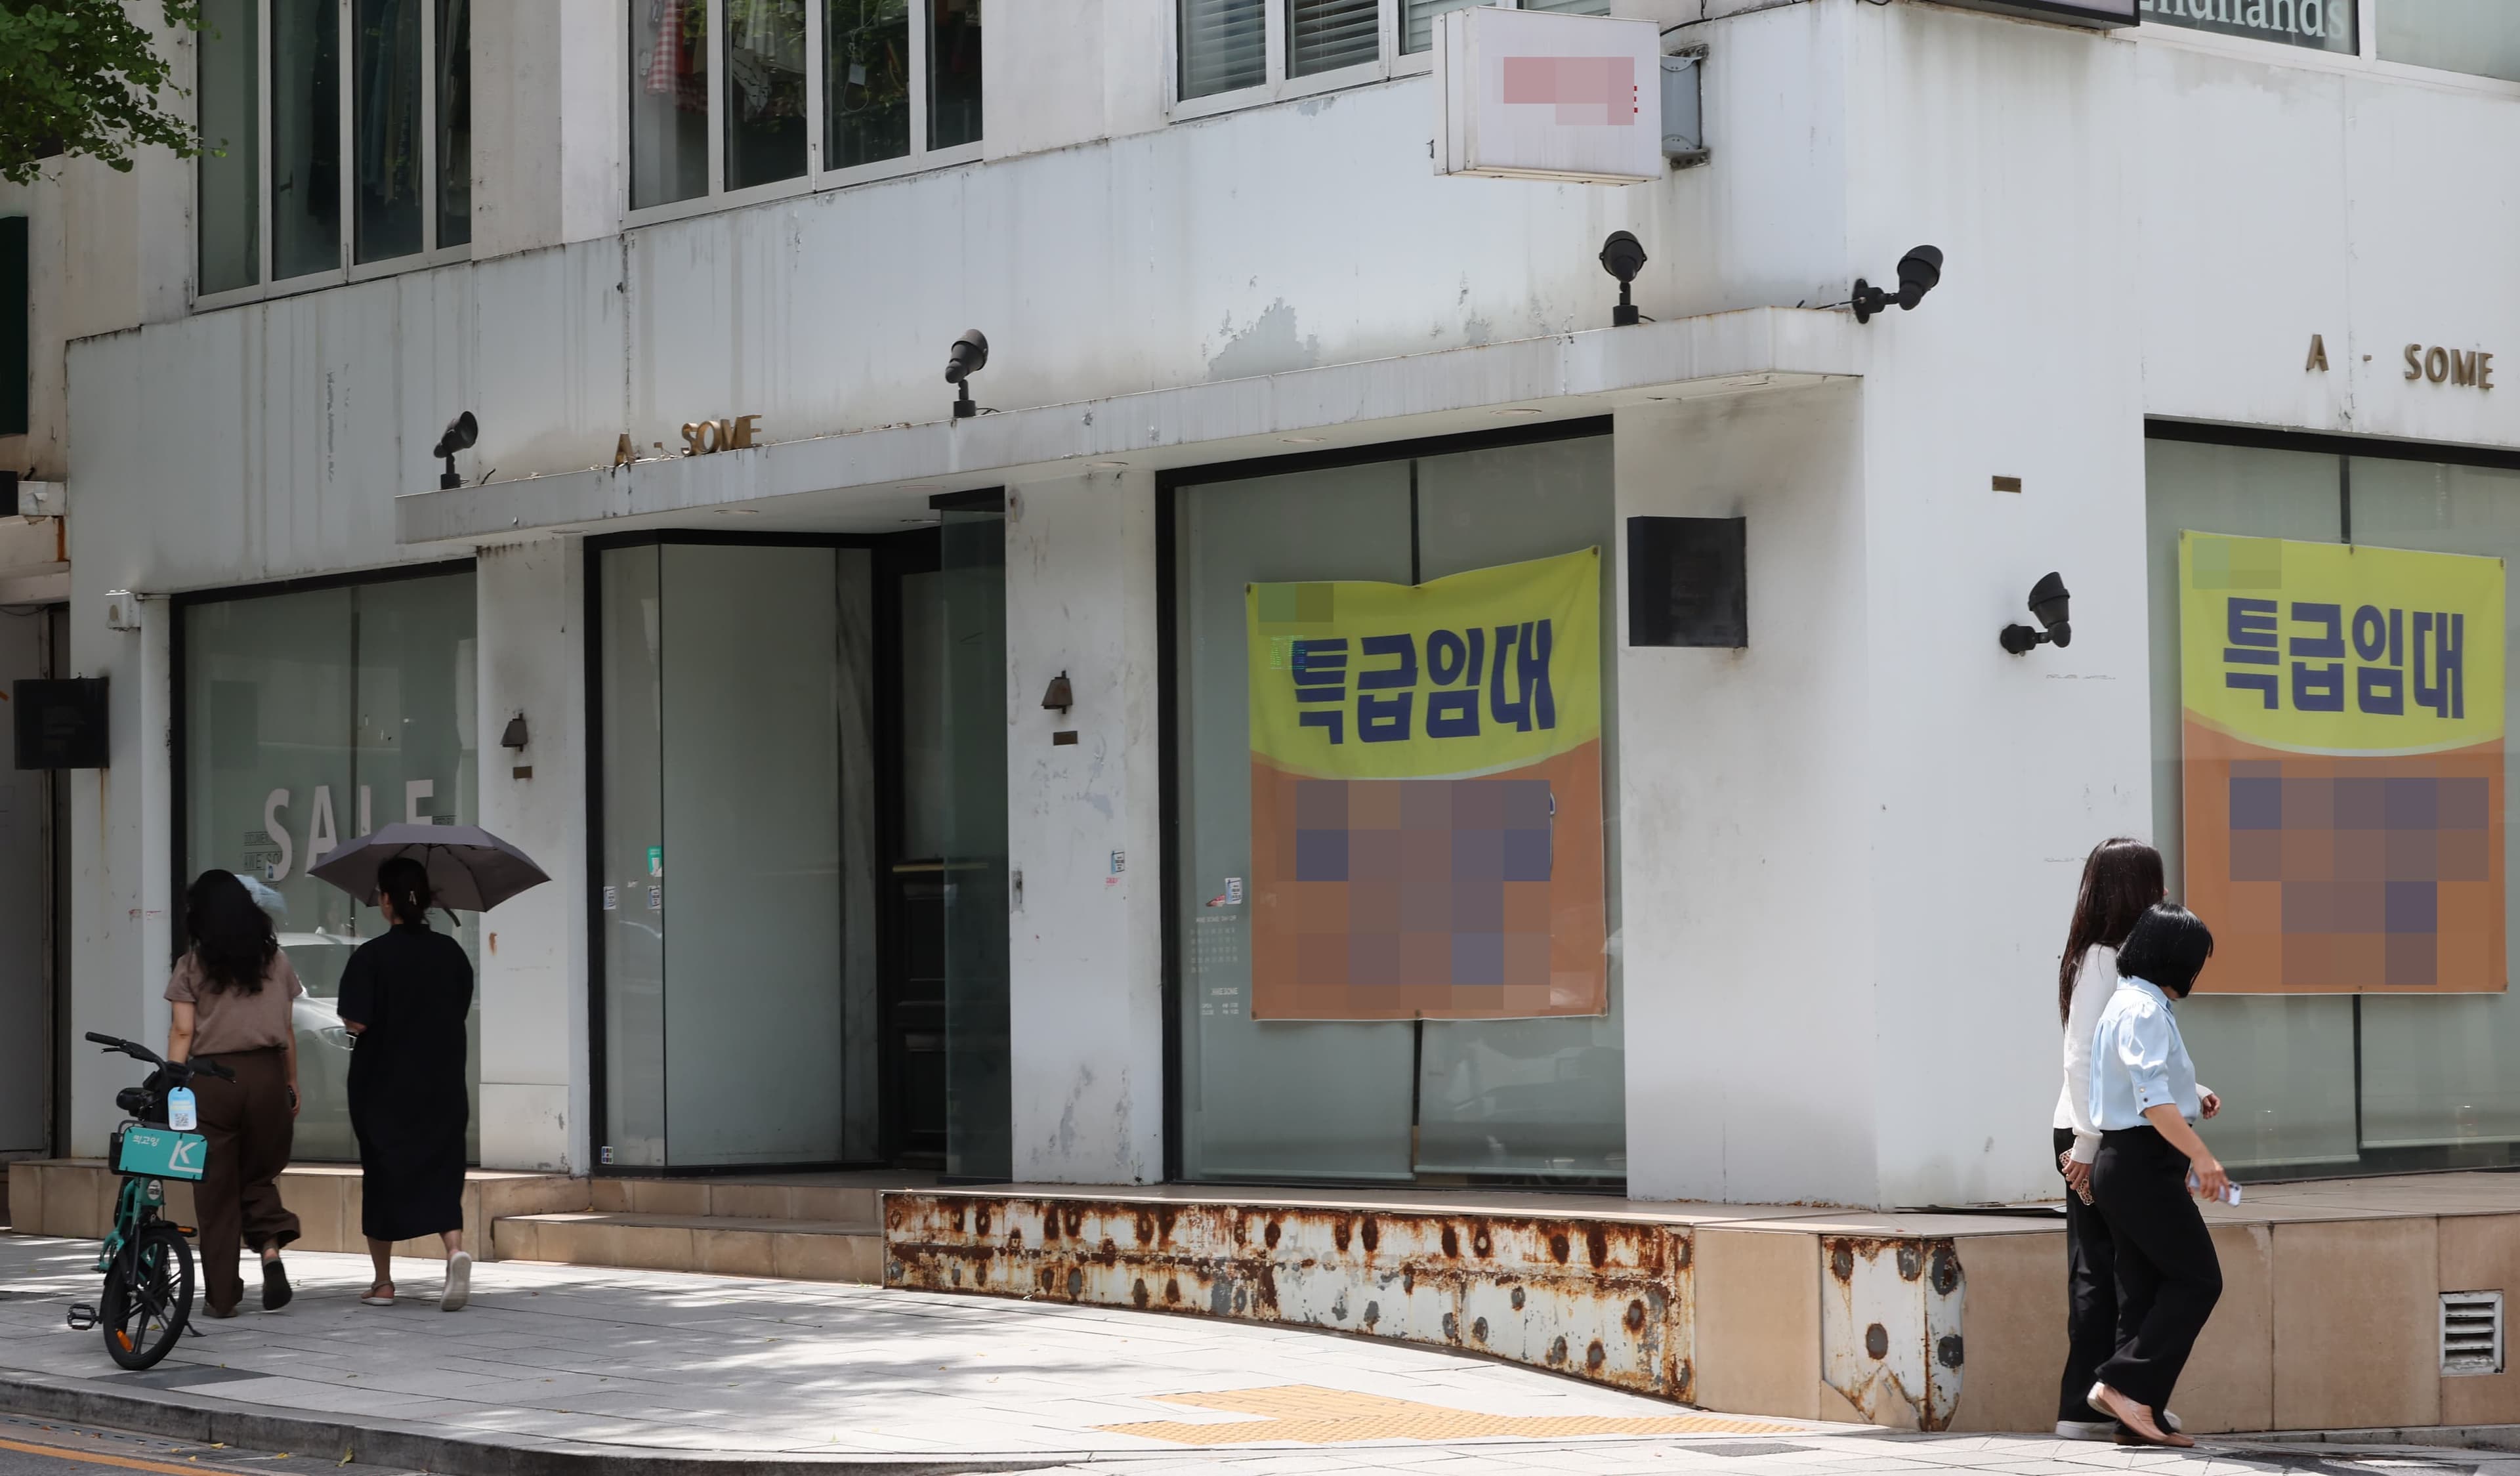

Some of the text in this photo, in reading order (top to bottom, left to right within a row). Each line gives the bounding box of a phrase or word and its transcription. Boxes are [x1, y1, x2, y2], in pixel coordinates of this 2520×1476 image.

[2305, 334, 2329, 373] A
[2404, 344, 2494, 390] SOME
[614, 433, 636, 467] A
[681, 415, 763, 456] SOME
[1292, 618, 1555, 744] 특급임대
[2223, 597, 2464, 719] 특급임대
[169, 1140, 203, 1174] K
